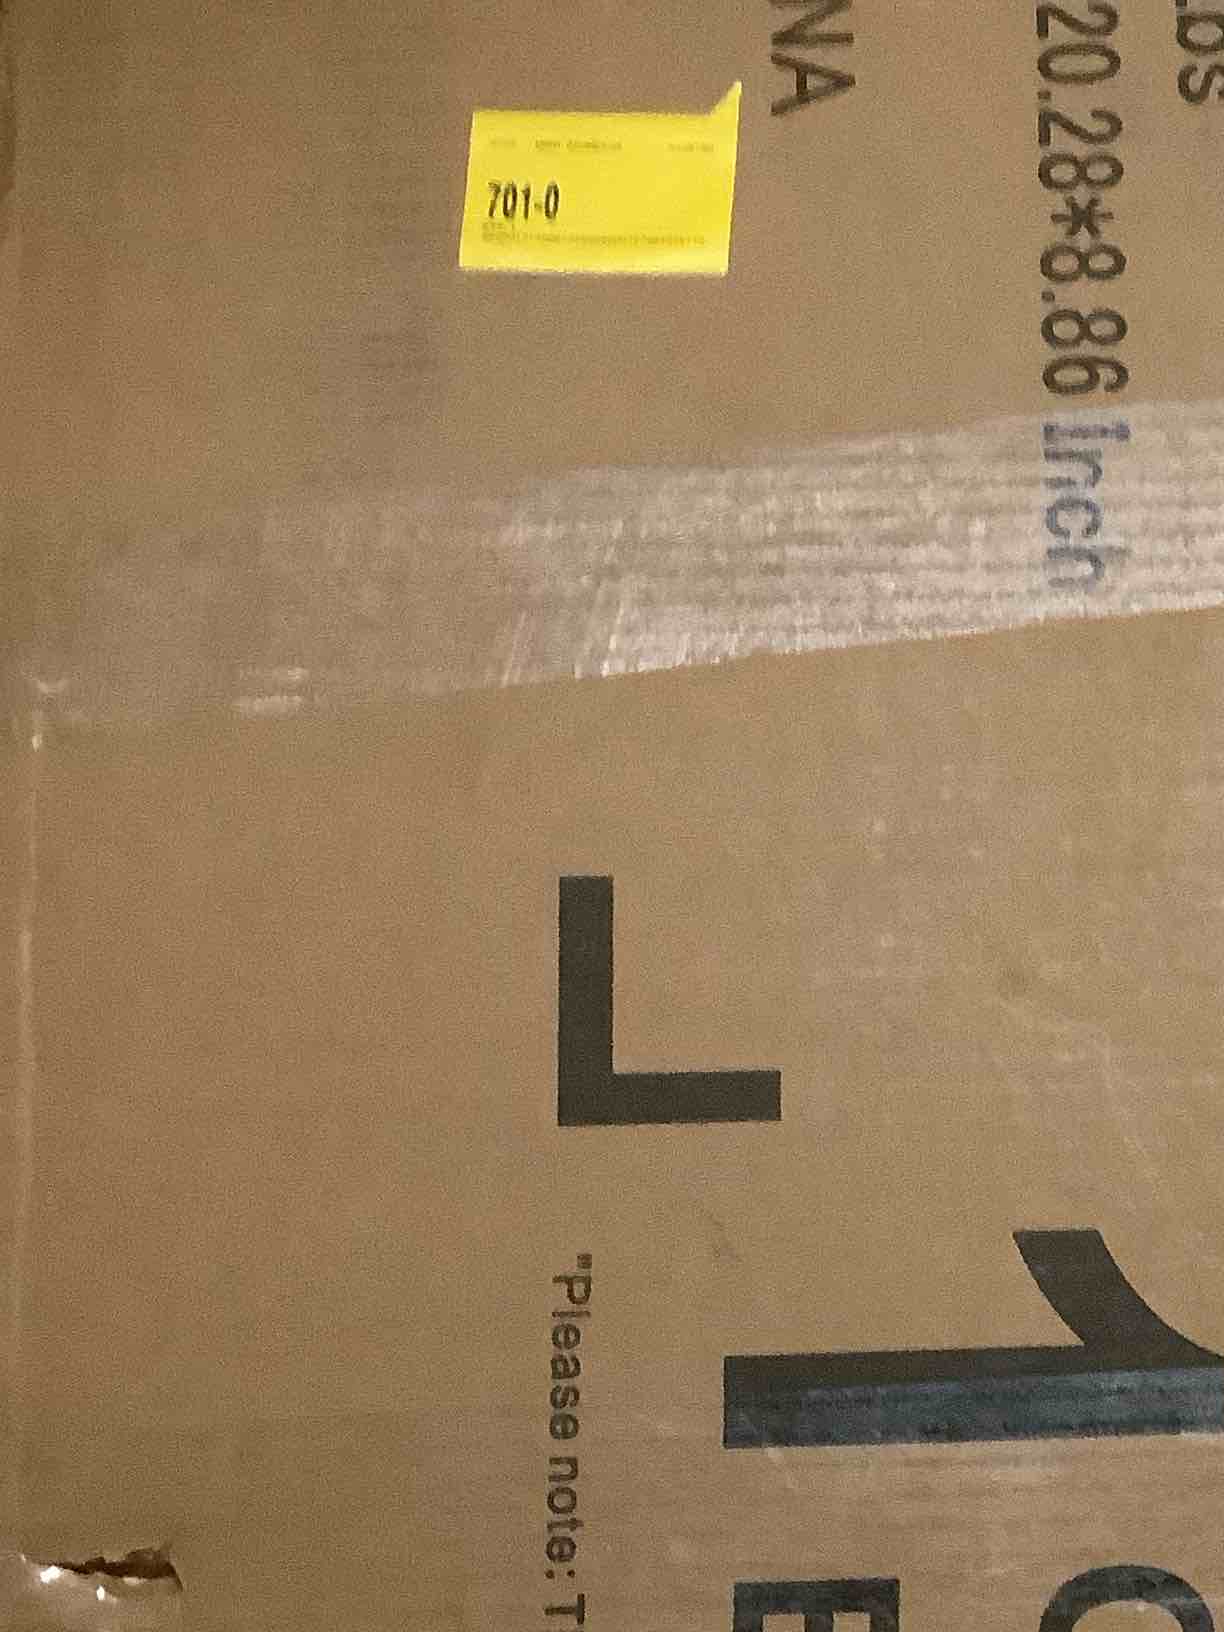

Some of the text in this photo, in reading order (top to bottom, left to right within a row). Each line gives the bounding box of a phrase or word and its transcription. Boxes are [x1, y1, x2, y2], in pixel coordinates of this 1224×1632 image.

[487, 179, 561, 221] 701-0
[1041, 422, 1131, 591] Inch
[543, 1456, 585, 1580] note:
